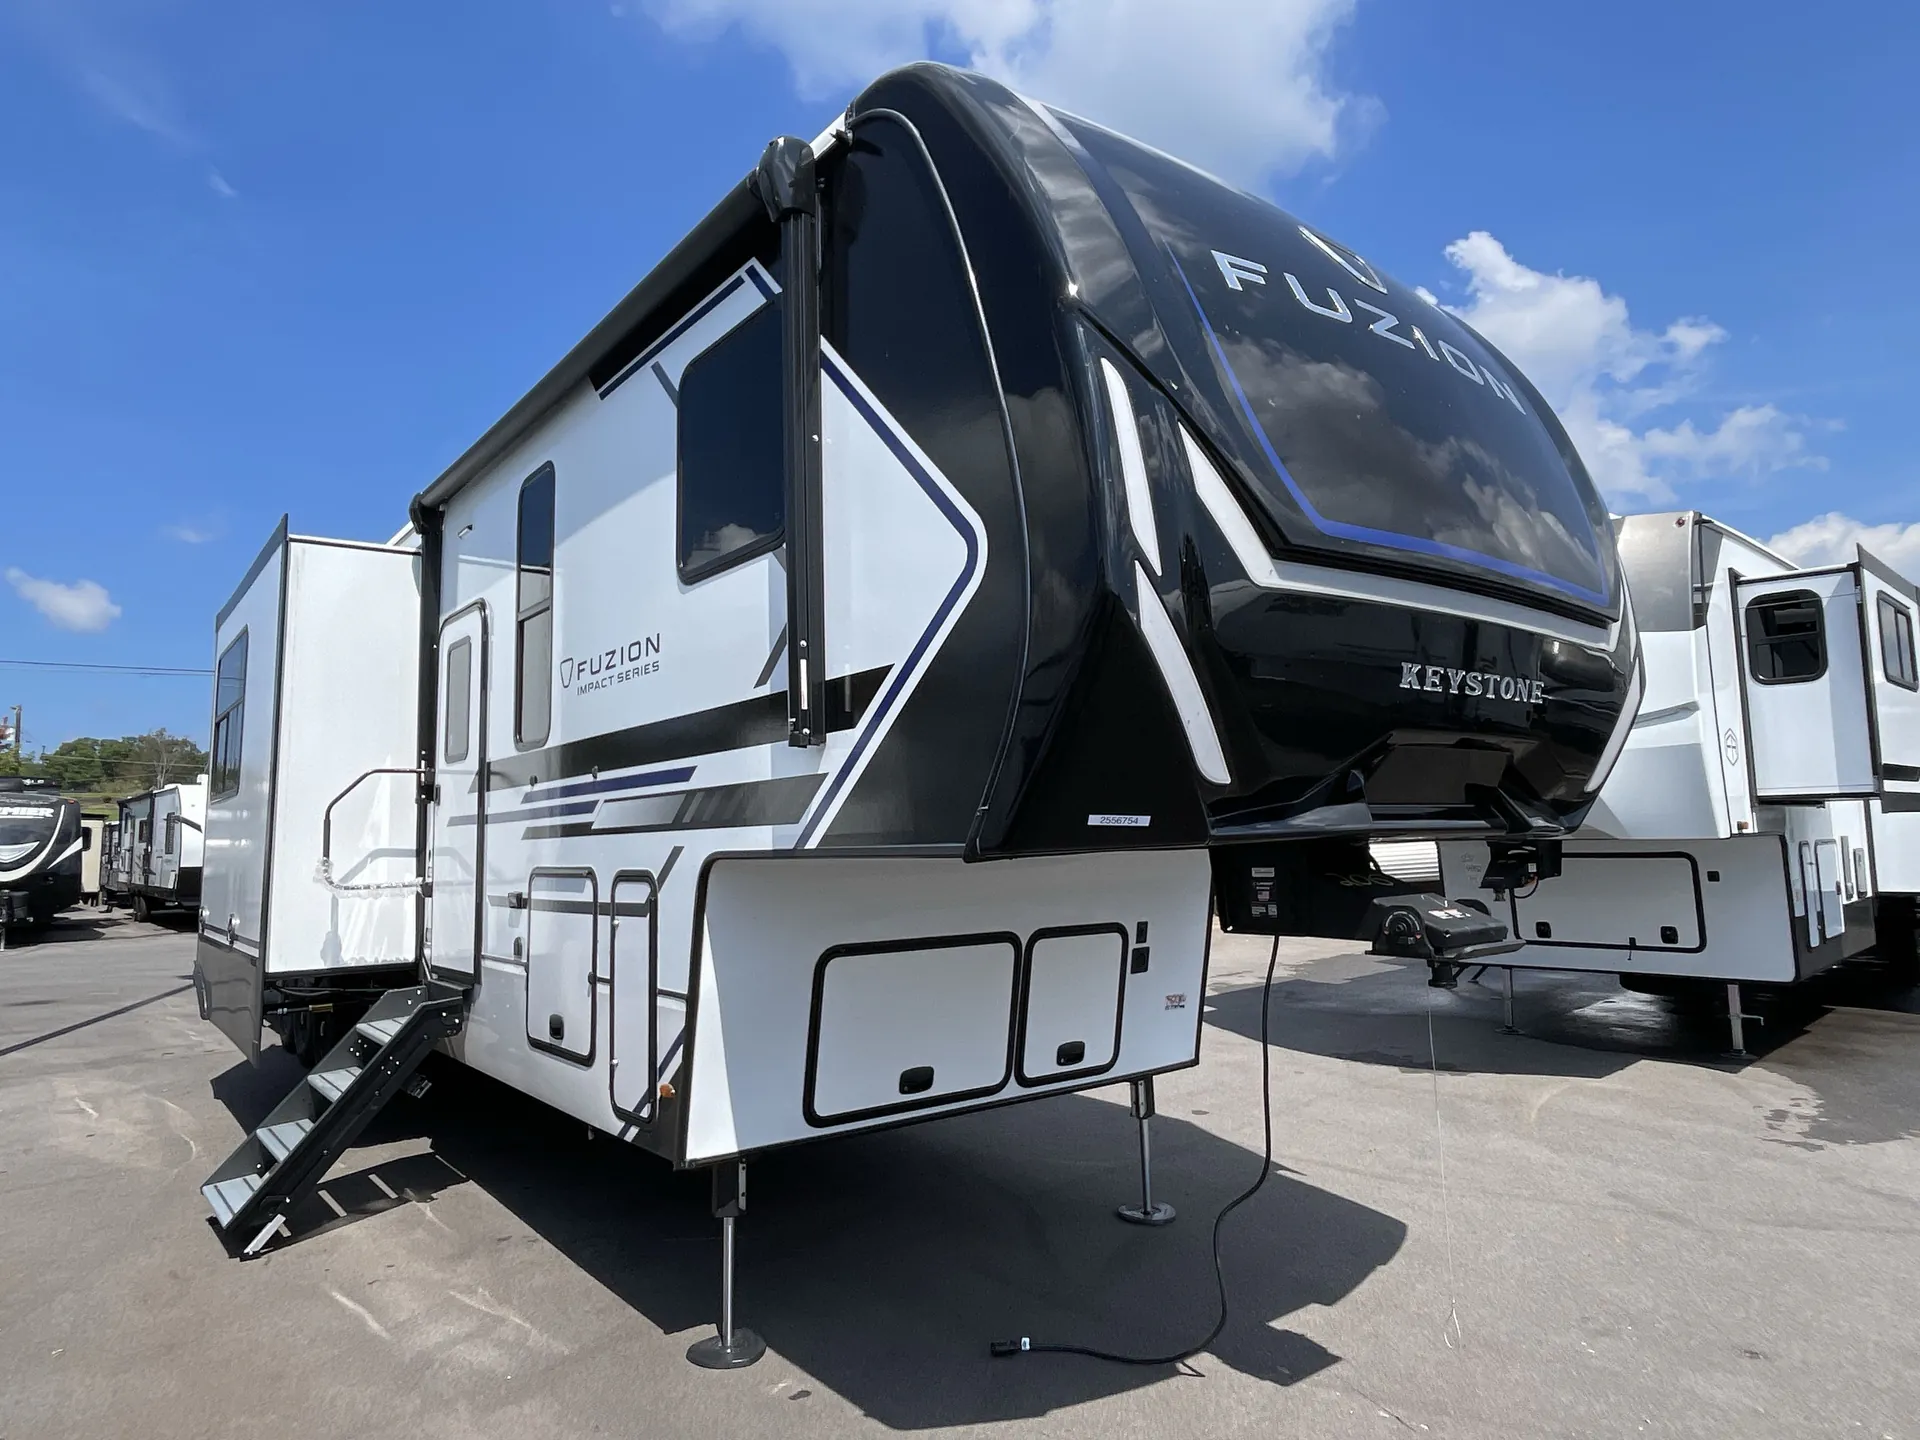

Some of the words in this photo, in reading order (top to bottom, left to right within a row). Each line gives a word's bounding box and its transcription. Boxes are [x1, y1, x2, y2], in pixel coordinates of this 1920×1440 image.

[1211, 250, 1526, 415] FUZION
[577, 632, 660, 681] FUZION
[577, 674, 615, 696] IMPACT
[617, 660, 660, 683] SERIES
[1399, 661, 1545, 704] KEYSTONE
[0, 806, 54, 818] MIER
[1100, 816, 1139, 824] 2556754
